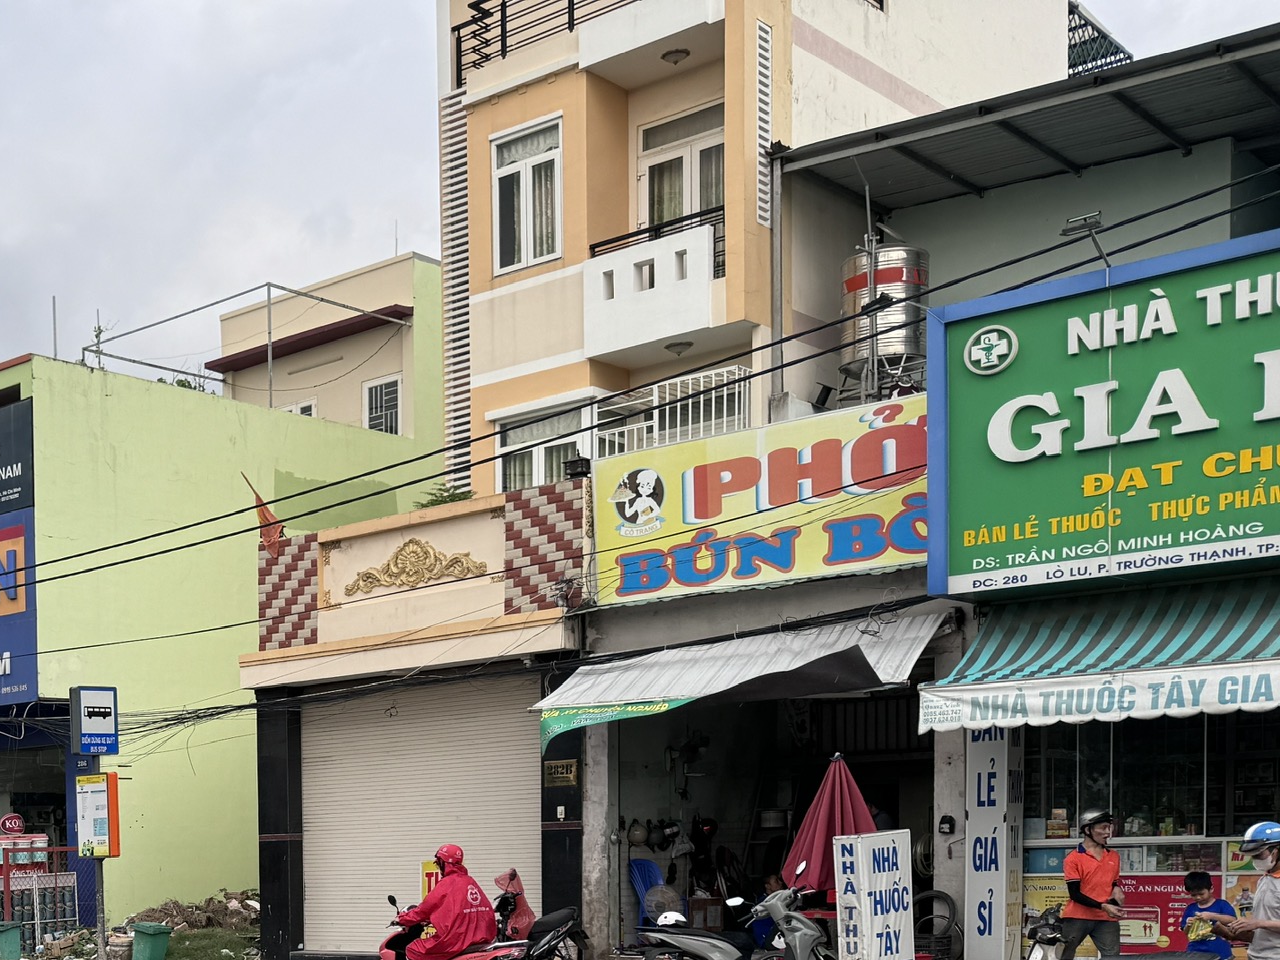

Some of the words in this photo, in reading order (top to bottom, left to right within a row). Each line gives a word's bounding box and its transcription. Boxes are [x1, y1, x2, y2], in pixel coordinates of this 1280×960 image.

[1068, 288, 1177, 355] NHÀ
[1196, 272, 1280, 325] TH
[987, 368, 1219, 462] GIA
[683, 404, 927, 521] PHỞ
[1082, 460, 1183, 497] ĐẠT
[1202, 445, 1280, 478] CH
[963, 524, 1006, 547] BÁN
[1013, 514, 1039, 540] LẺ
[1048, 503, 1122, 535] THUỐC
[1148, 494, 1210, 522] THỰC
[616, 528, 801, 597] BÚN
[972, 556, 1001, 570] DS:
[1006, 542, 1055, 565] TRẦN
[1062, 538, 1109, 558] NGÔ
[1117, 534, 1173, 551] MINH
[1180, 522, 1265, 544] HOÀNG
[972, 577, 998, 589] ĐC:
[1002, 574, 1028, 585] 280
[1046, 565, 1065, 581] LÒ
[1070, 565, 1092, 578] LU,
[1097, 563, 1109, 574] P.
[1116, 552, 1184, 572] TRƯỜNG
[1257, 543, 1280, 555] TP:
[970, 687, 1028, 722] NHÀ
[1039, 677, 1137, 717] THUỐC
[1147, 674, 1207, 709] TÂY
[1218, 673, 1274, 705] GIA
[547, 764, 573, 776] 282B
[977, 757, 997, 808] LẺ
[872, 839, 899, 873] NHÀ
[973, 826, 999, 872] GIÁ
[867, 877, 909, 916] THUỐC
[977, 888, 994, 936] SỈ
[876, 924, 901, 957] TÂY
